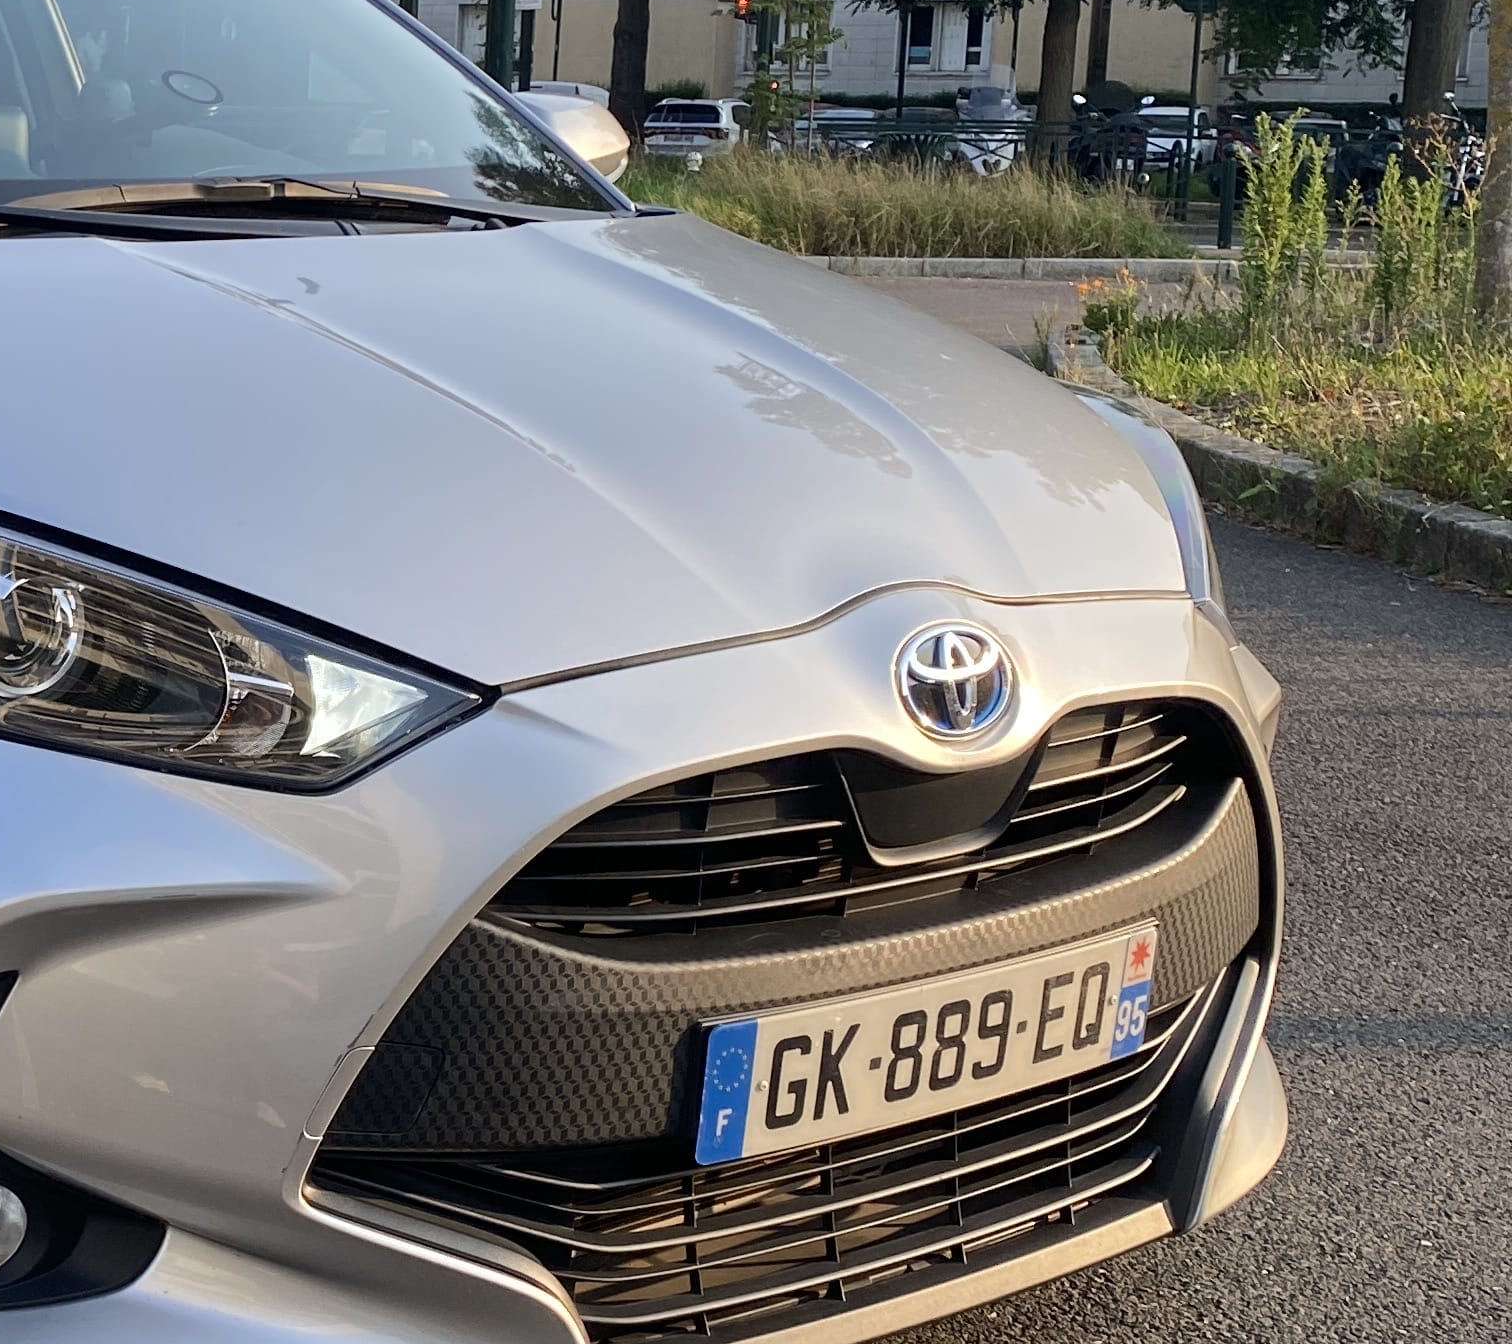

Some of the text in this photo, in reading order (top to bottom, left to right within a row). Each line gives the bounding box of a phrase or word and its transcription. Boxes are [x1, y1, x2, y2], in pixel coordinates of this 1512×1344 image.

[1115, 994, 1147, 1042] 95
[765, 962, 1110, 1130] GK-889-EQ
[716, 1108, 733, 1137] F
